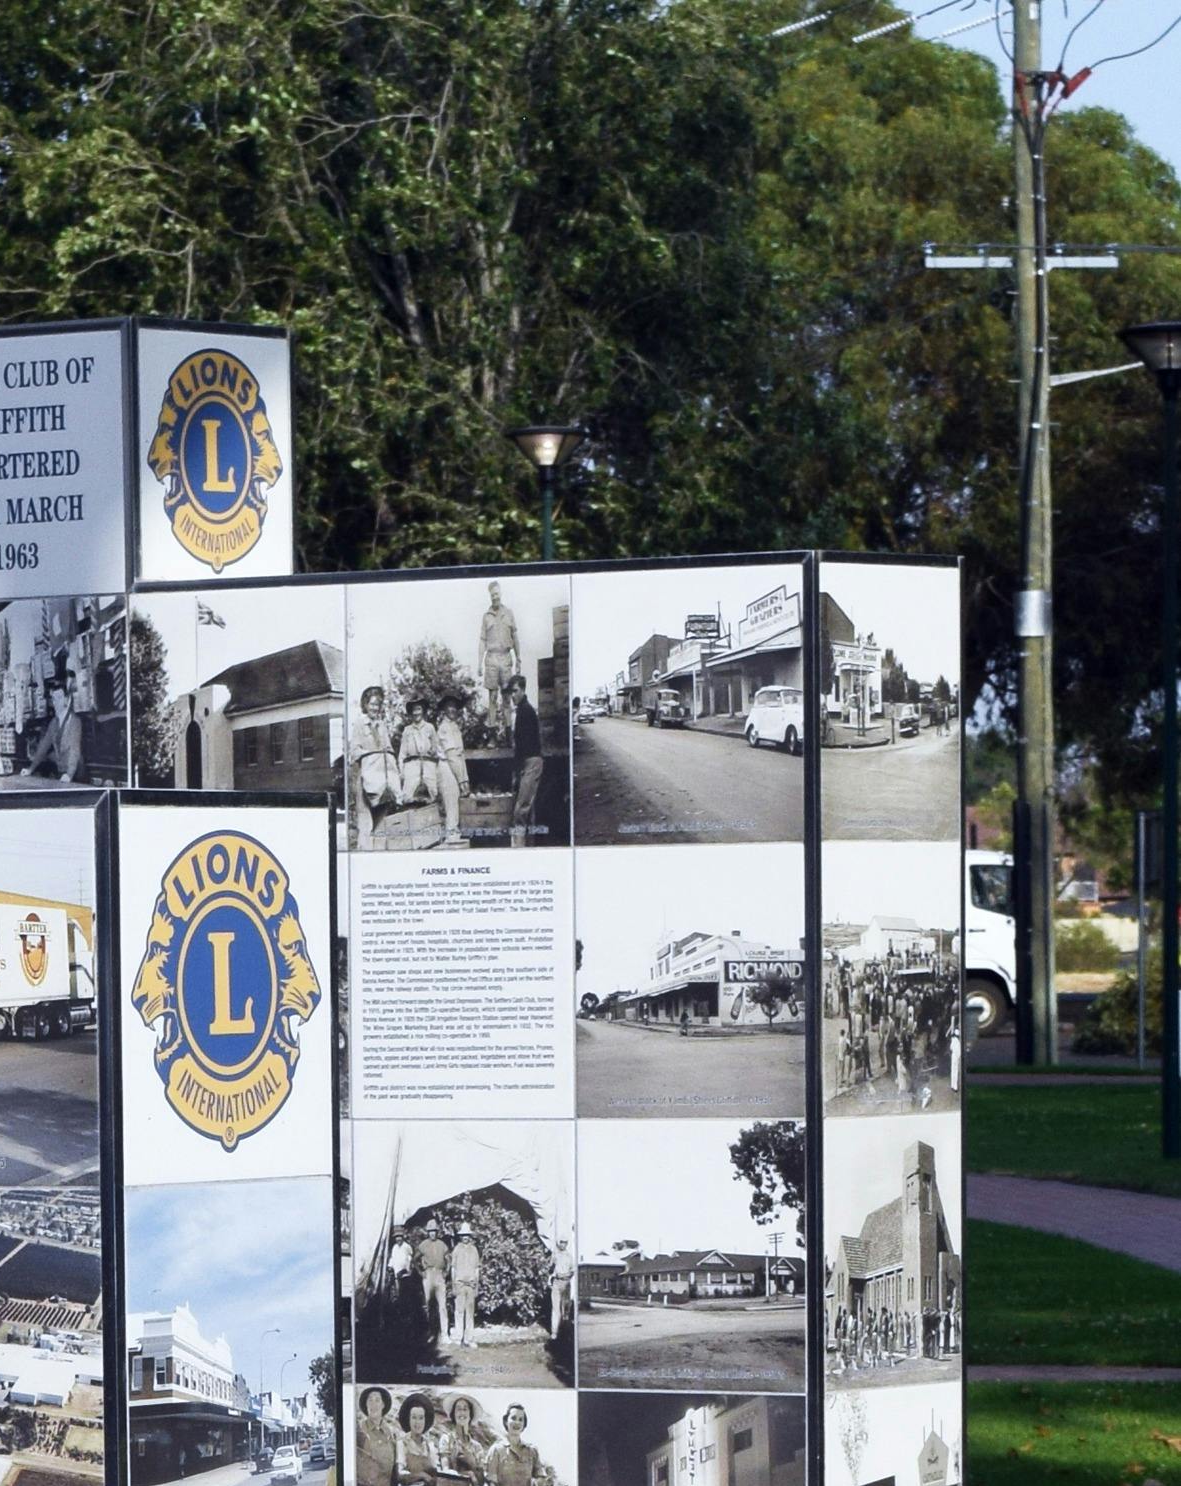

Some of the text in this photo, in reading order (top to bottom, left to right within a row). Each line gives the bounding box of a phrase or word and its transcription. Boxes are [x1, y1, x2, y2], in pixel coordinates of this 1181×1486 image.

[3, 360, 59, 389] CLUB
[65, 356, 95, 385] OF
[176, 357, 253, 406] LIONS
[201, 419, 237, 493] L
[6, 494, 84, 525] MARCH
[179, 513, 256, 555] INTERNATIONAL
[172, 843, 280, 910] LIONS
[422, 866, 491, 875] FARMS & FINANCE
[19, 923, 47, 934] BARTTER
[207, 932, 255, 1035] L
[729, 961, 802, 981] RICHMOND
[176, 1068, 282, 1123] INTERNATIONAL
